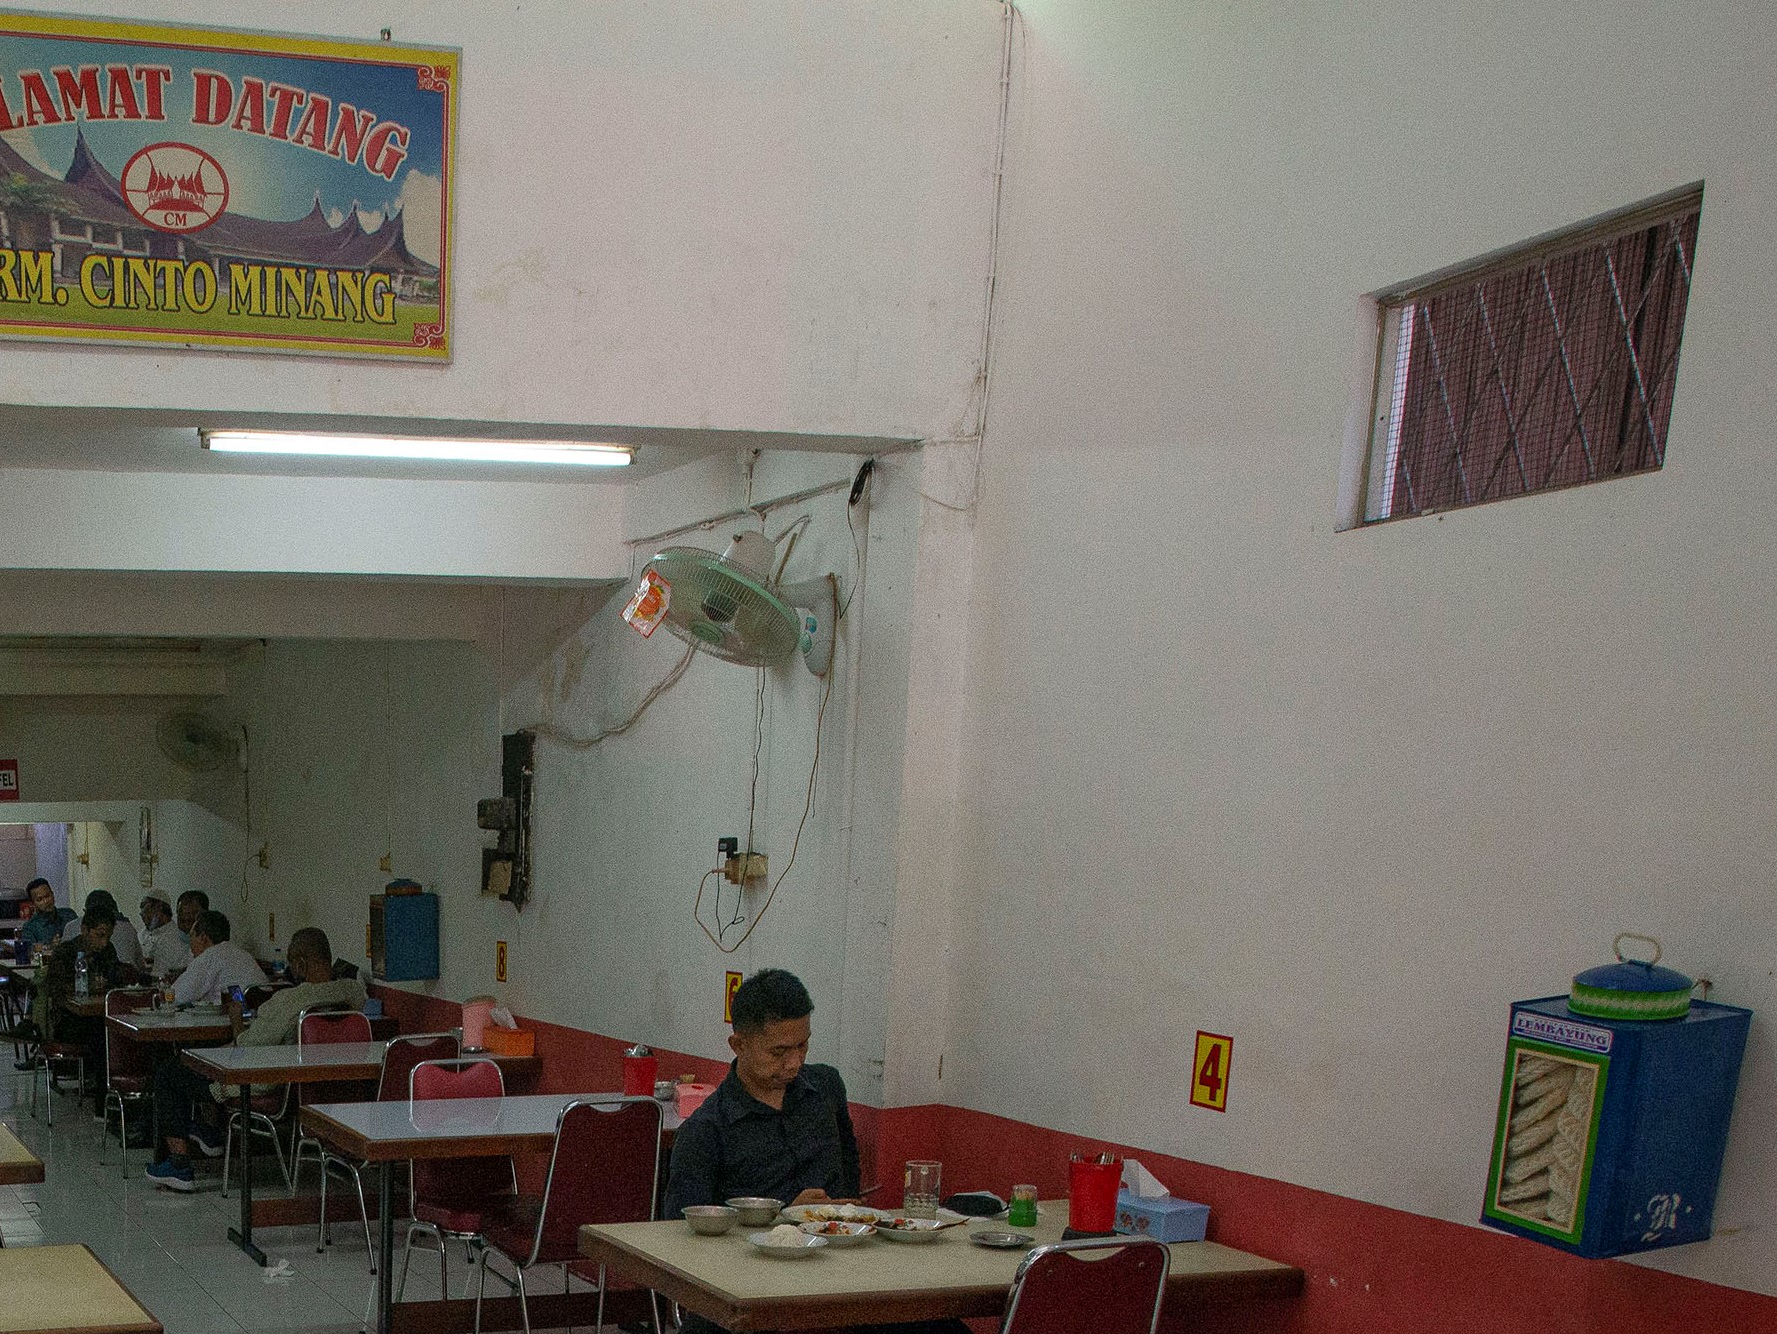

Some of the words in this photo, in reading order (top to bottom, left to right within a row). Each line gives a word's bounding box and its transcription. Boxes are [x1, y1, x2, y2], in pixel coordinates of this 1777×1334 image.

[192, 68, 412, 182] DATANG
[163, 212, 187, 227] CM
[80, 253, 217, 316] CINTO
[228, 263, 397, 326] MINANG
[1198, 1043, 1222, 1102] 4
